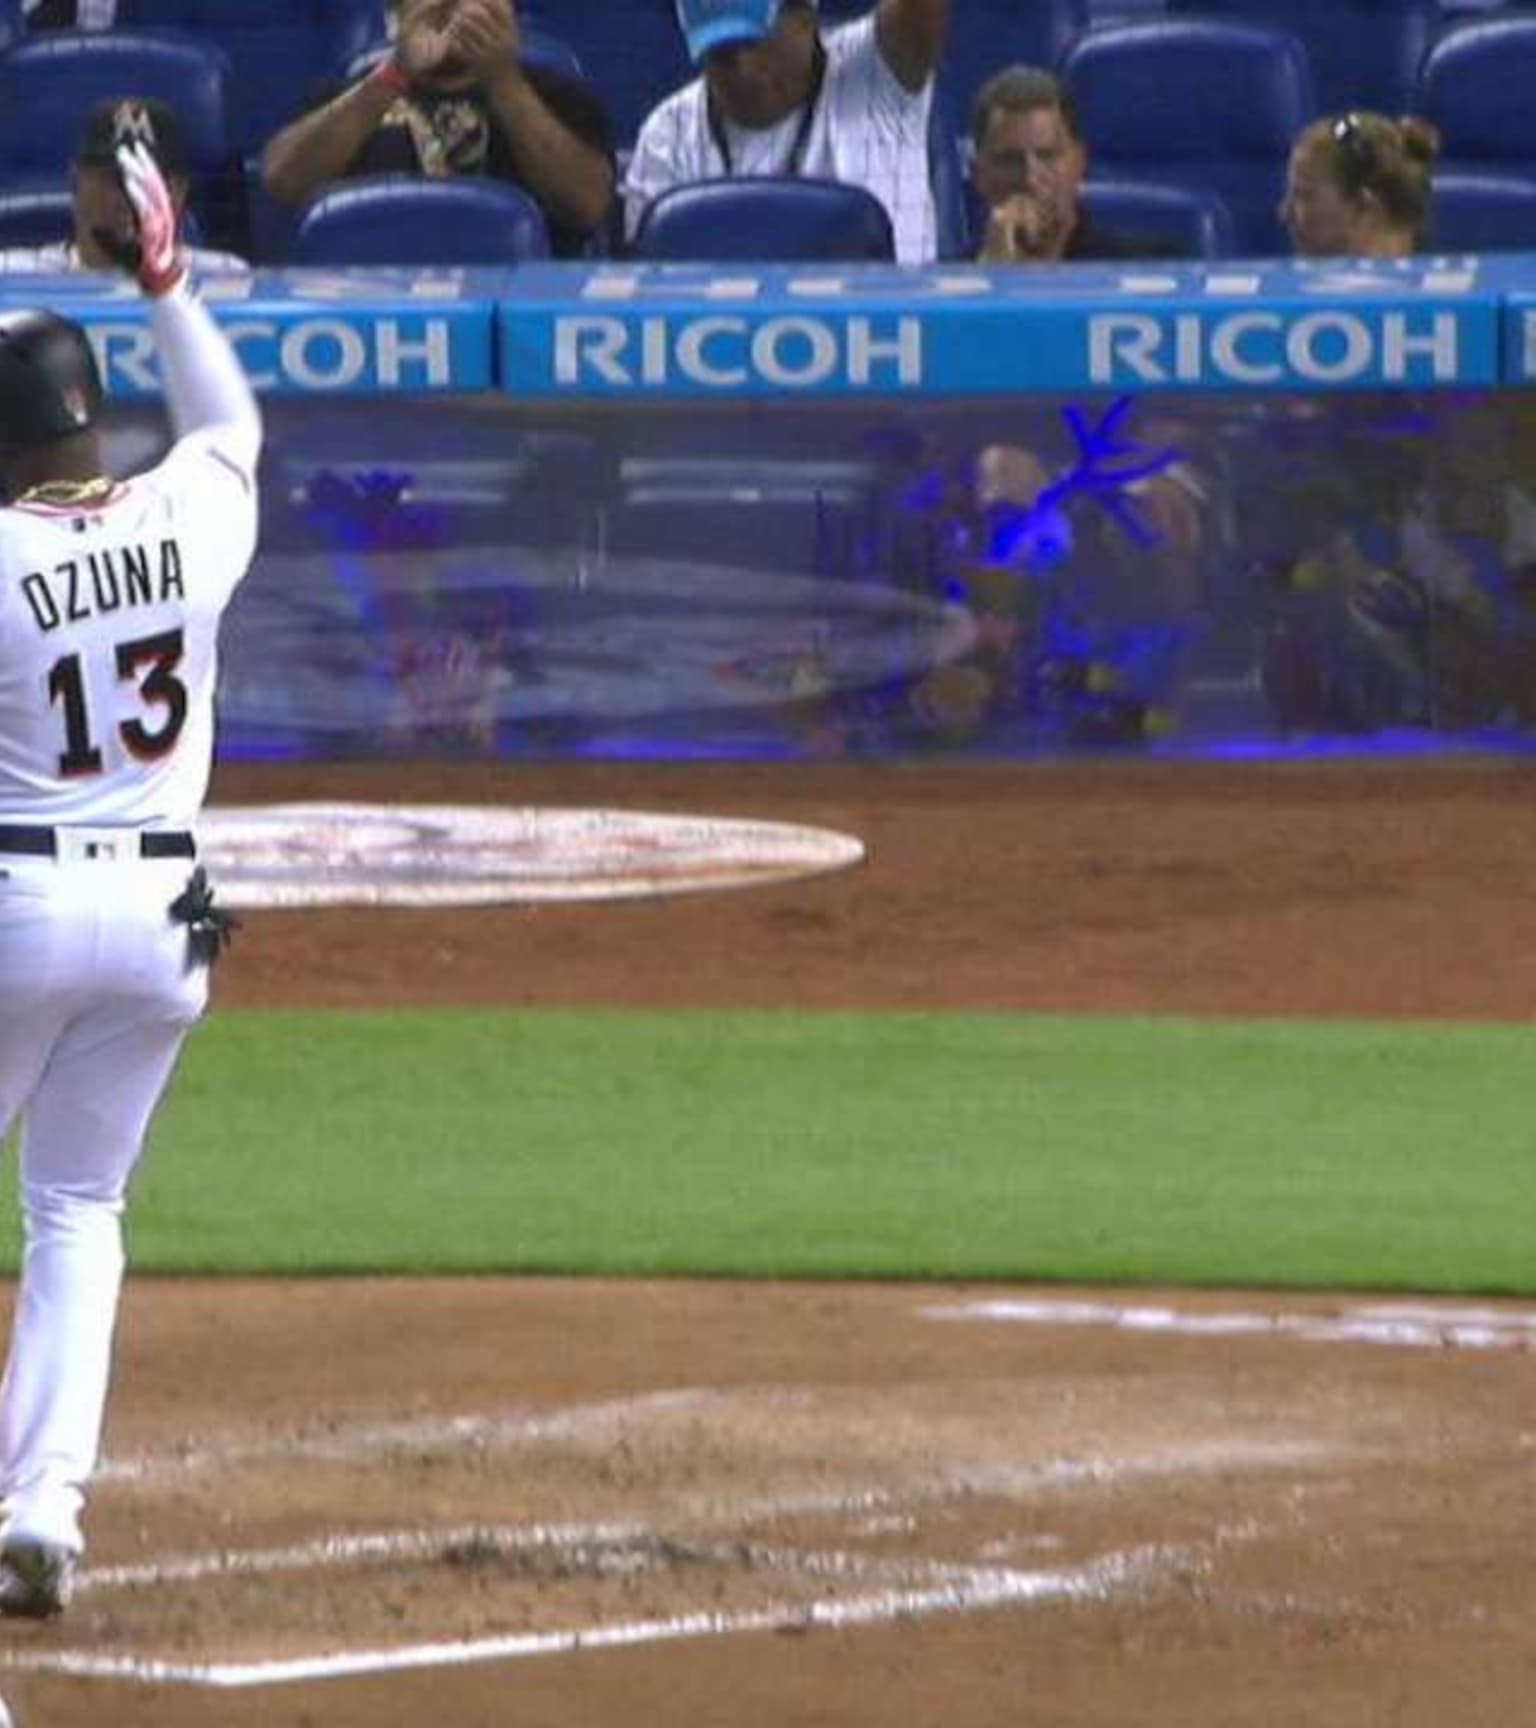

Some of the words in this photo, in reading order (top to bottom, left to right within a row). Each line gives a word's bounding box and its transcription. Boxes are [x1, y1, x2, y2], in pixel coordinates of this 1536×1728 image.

[86, 318, 450, 391] ROH
[552, 316, 923, 385] RICOH
[1087, 310, 1459, 384] RICOH
[20, 538, 185, 632] OZUNA
[48, 626, 188, 780] 13
